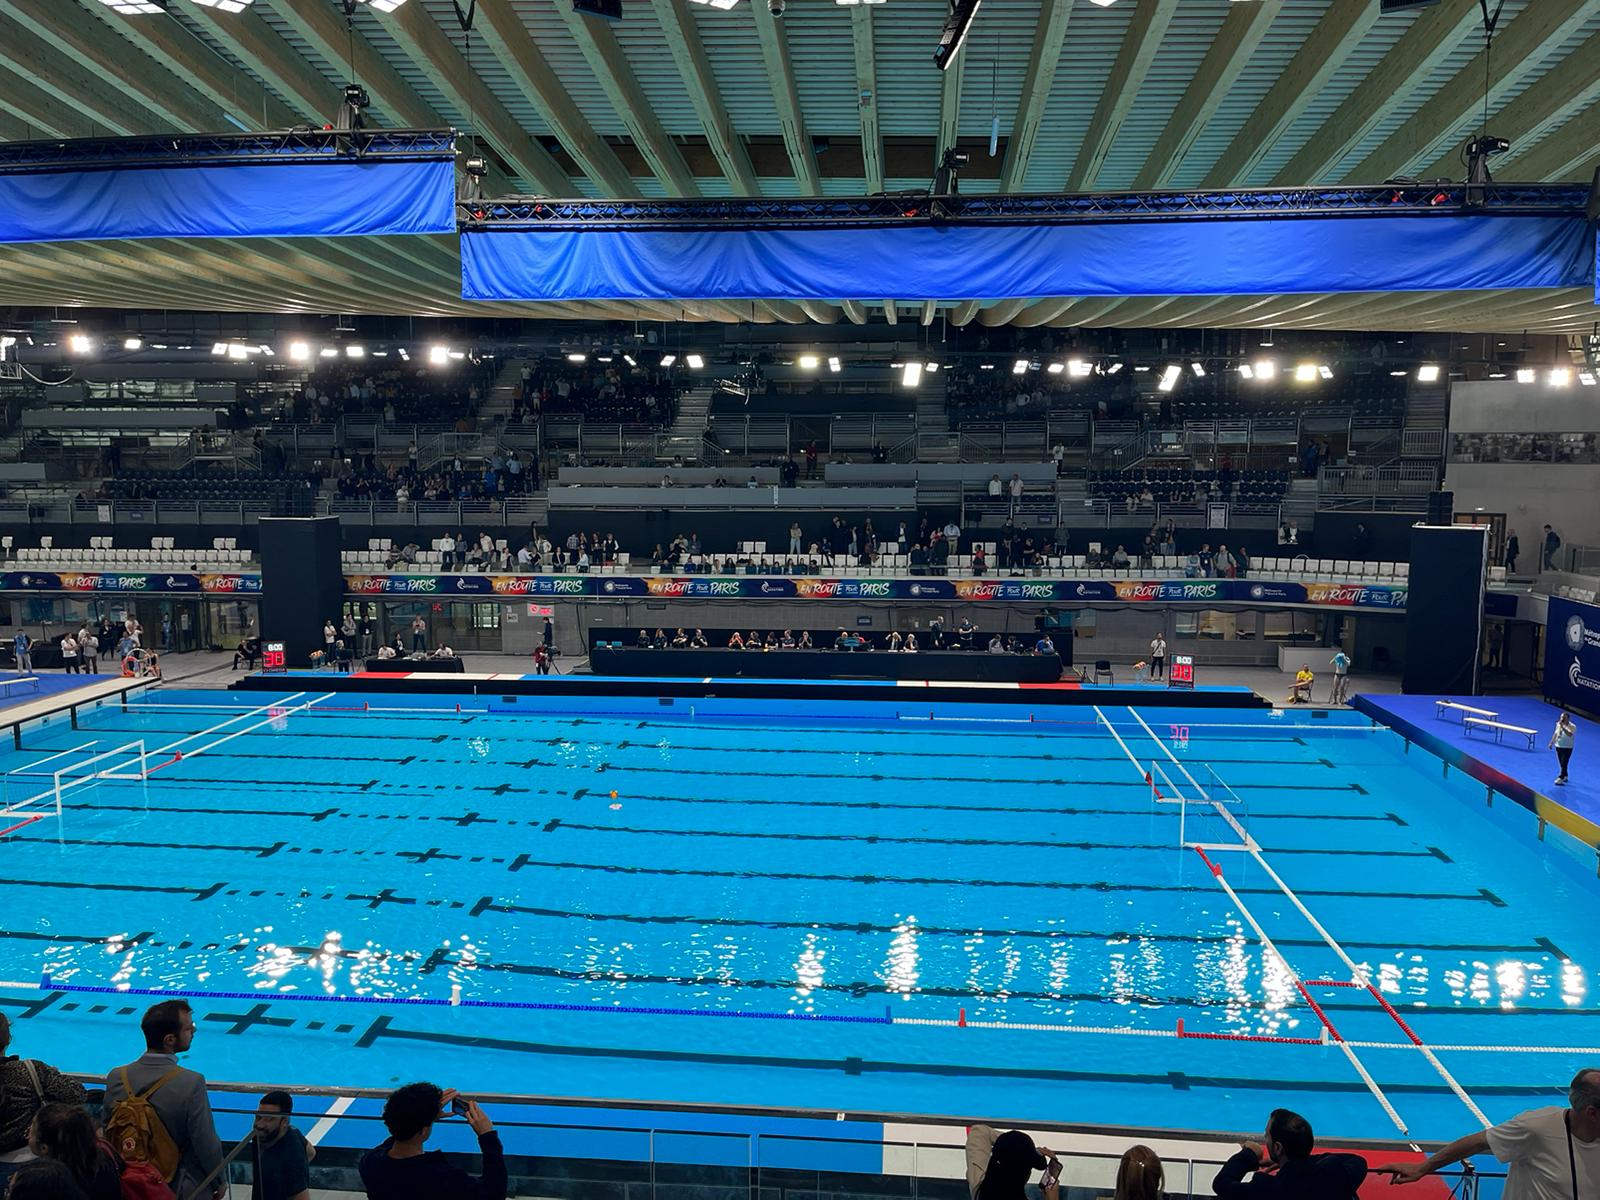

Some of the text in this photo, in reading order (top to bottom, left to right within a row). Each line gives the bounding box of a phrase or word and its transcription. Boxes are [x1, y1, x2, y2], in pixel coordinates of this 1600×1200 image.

[76, 576, 103, 588] ROUTE
[118, 577, 146, 589] PARIS
[204, 581, 215, 589] EN
[216, 577, 243, 589] ROUTE
[352, 582, 363, 590] EN
[363, 579, 392, 591] ROUTE
[407, 579, 437, 592] PARIS
[495, 583, 508, 591] EN
[508, 580, 537, 592] ROUTE
[553, 580, 583, 592] PARIS
[652, 584, 664, 593] EN
[664, 581, 694, 594] ROUTE
[709, 581, 740, 594] PARIS
[800, 585, 814, 594] EN
[814, 583, 843, 595] ROUTE
[859, 582, 890, 596] PARIS
[960, 586, 973, 596] EN
[973, 584, 1004, 597] ROUTE
[1021, 584, 1053, 598] PARIS
[1120, 588, 1133, 597] EN
[1133, 585, 1165, 597] ROUTE
[1183, 584, 1217, 598] PARIS
[1311, 590, 1326, 601] EN
[1327, 587, 1369, 603] ROUTE
[263, 651, 285, 667] 30
